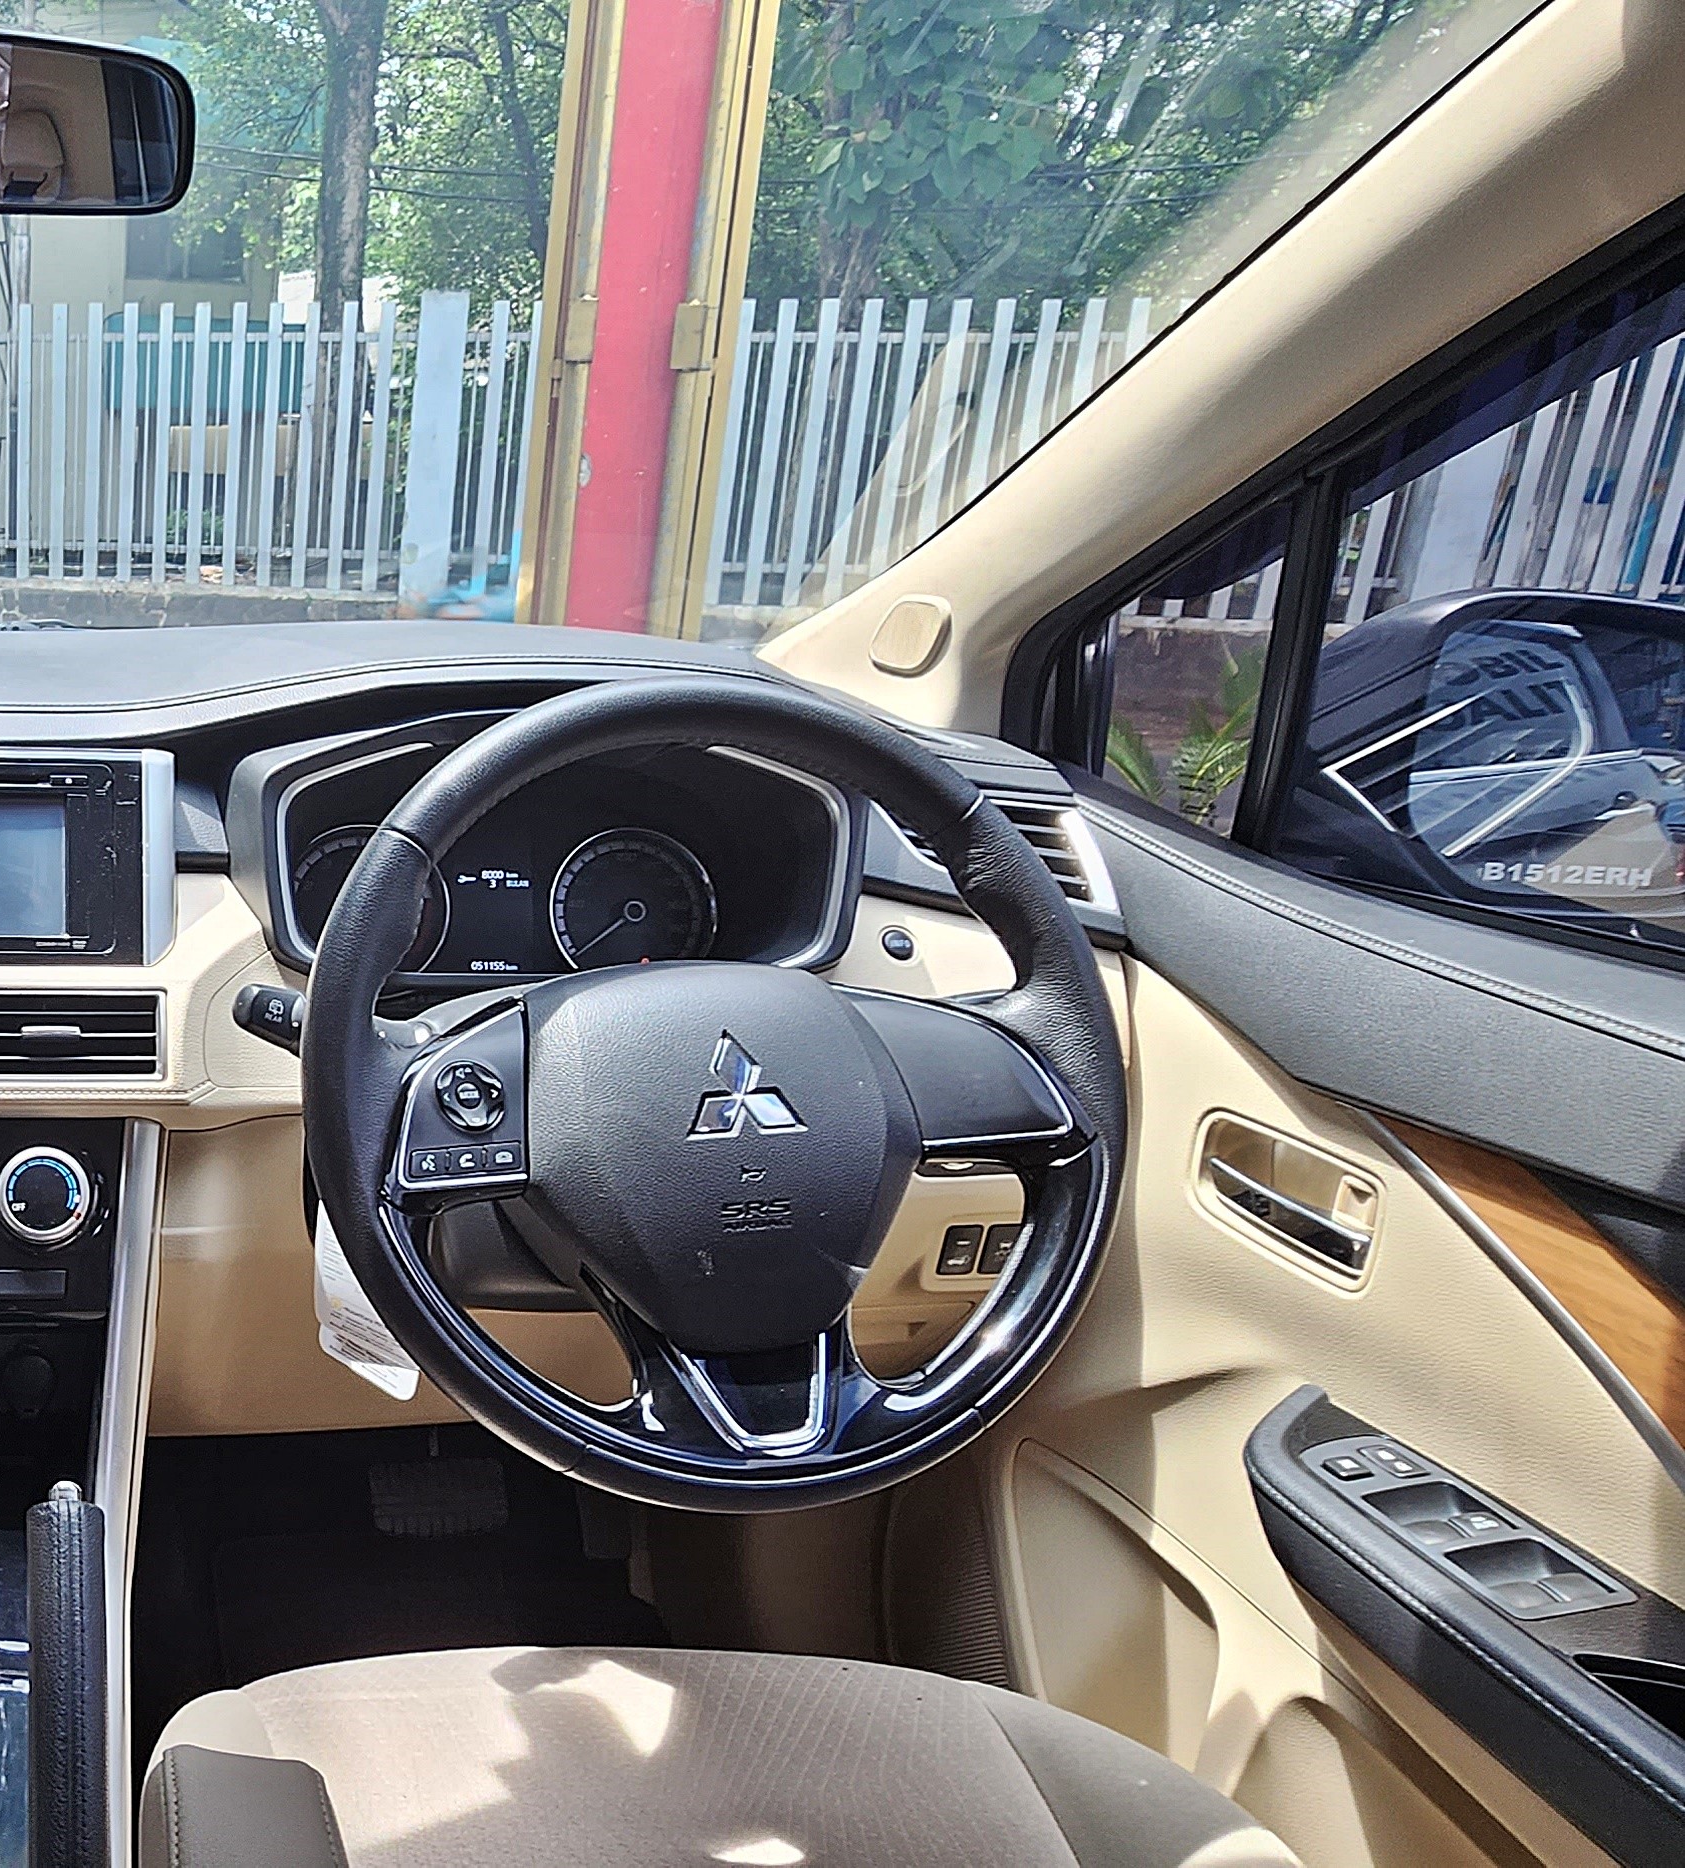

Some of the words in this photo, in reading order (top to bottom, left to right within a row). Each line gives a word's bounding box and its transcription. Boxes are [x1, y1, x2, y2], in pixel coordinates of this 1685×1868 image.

[1481, 862, 1653, 887] B1512ERH
[489, 879, 497, 888] 3
[470, 960, 505, 971] 051155
[11, 1202, 26, 1212] OFF
[718, 1200, 792, 1219] SRS
